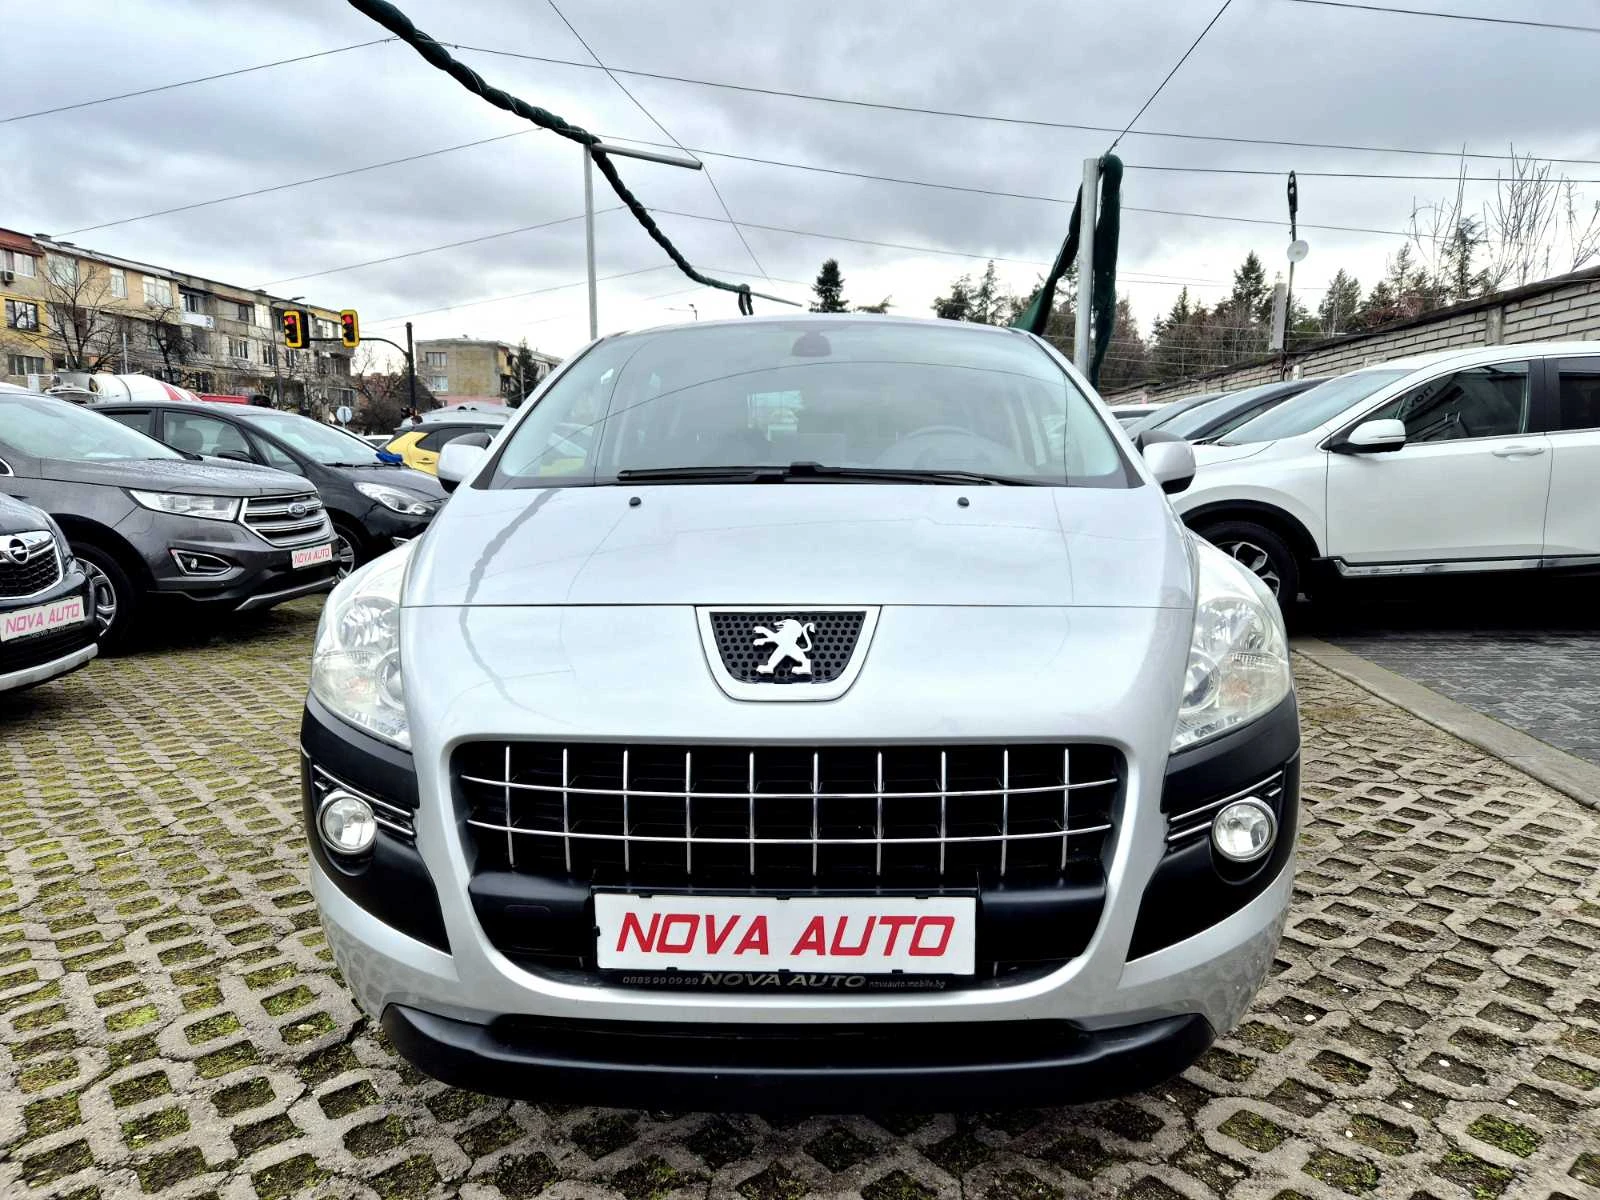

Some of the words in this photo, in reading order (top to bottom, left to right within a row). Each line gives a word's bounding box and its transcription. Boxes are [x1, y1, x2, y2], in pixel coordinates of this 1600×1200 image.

[295, 552, 311, 564] NOVA
[313, 548, 329, 560] AUTO
[6, 612, 43, 633] NOVA
[49, 603, 80, 624] AUTO
[616, 912, 769, 956] NOVA
[790, 915, 955, 957] AUTO
[701, 973, 782, 986] NOVA
[787, 974, 866, 988] AUTO
